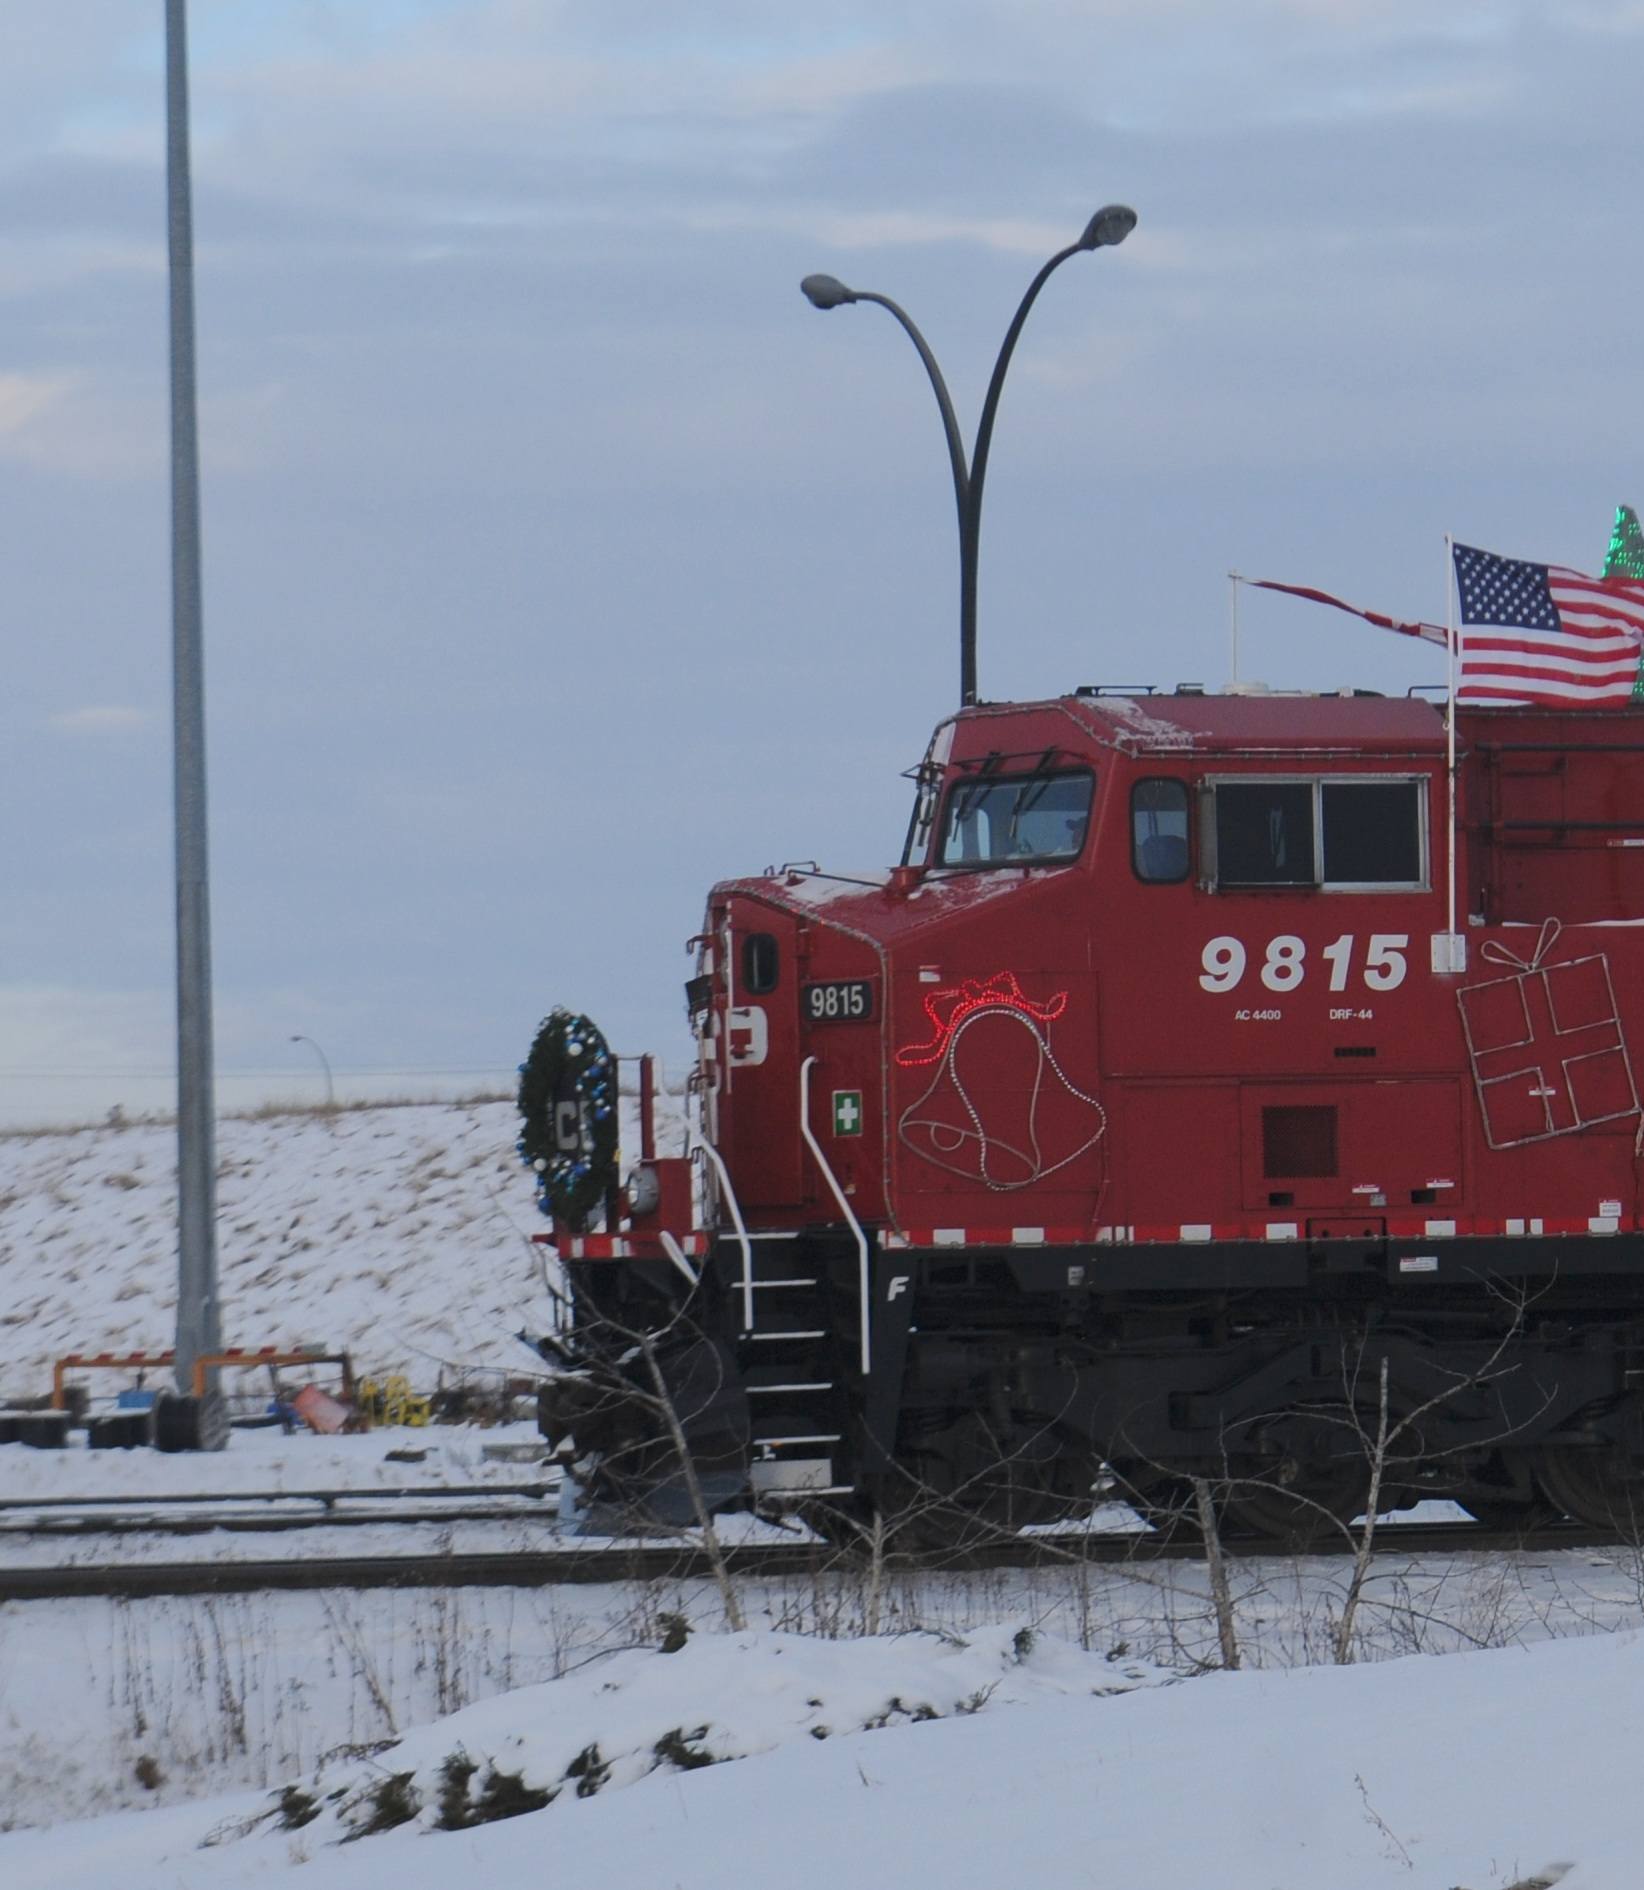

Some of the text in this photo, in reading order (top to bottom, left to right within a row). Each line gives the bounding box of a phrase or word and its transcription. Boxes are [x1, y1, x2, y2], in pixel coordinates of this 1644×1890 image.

[1199, 934, 1409, 993] 9815
[811, 985, 864, 1017] 9815
[1235, 1010, 1281, 1020] AC 4400
[1329, 1008, 1373, 1020] DRF-44
[887, 1276, 909, 1301] F
